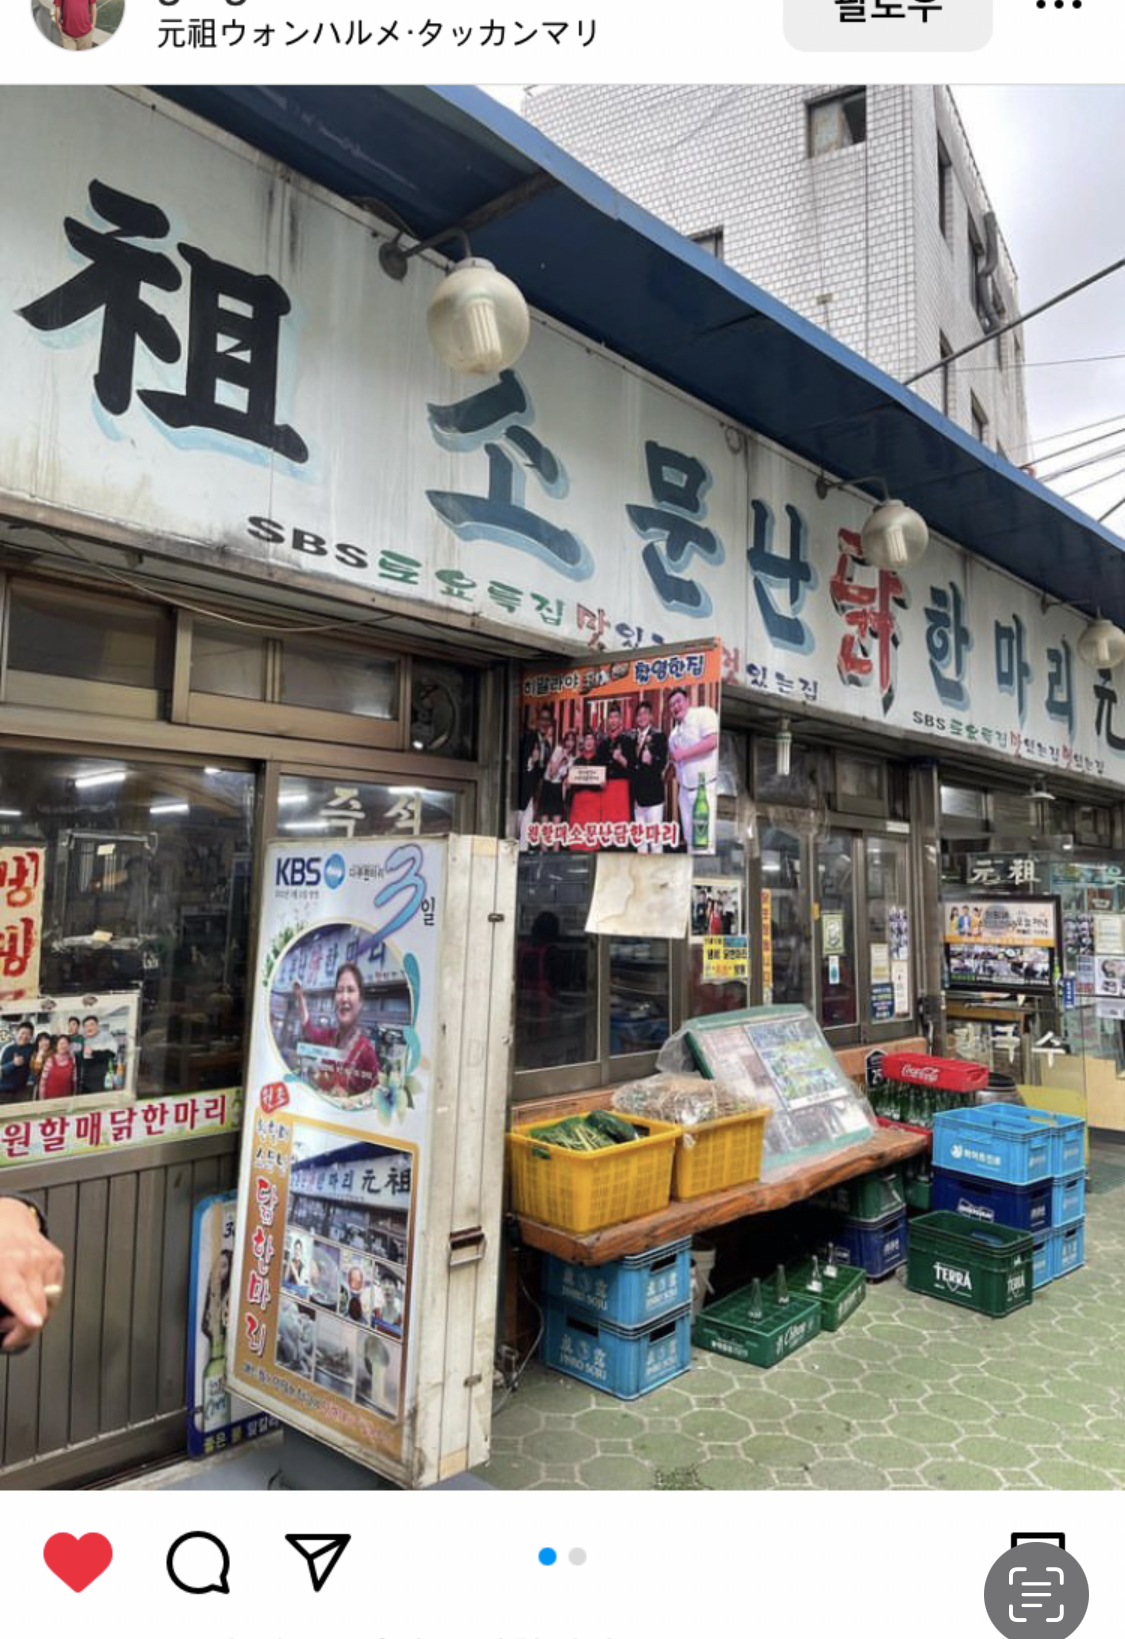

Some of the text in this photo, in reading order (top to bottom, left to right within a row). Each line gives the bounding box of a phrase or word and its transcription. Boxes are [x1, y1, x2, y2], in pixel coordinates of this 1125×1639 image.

[14, 178, 309, 464] 祖
[275, 856, 322, 886] KBS
[933, 1262, 973, 1291] TERRA
